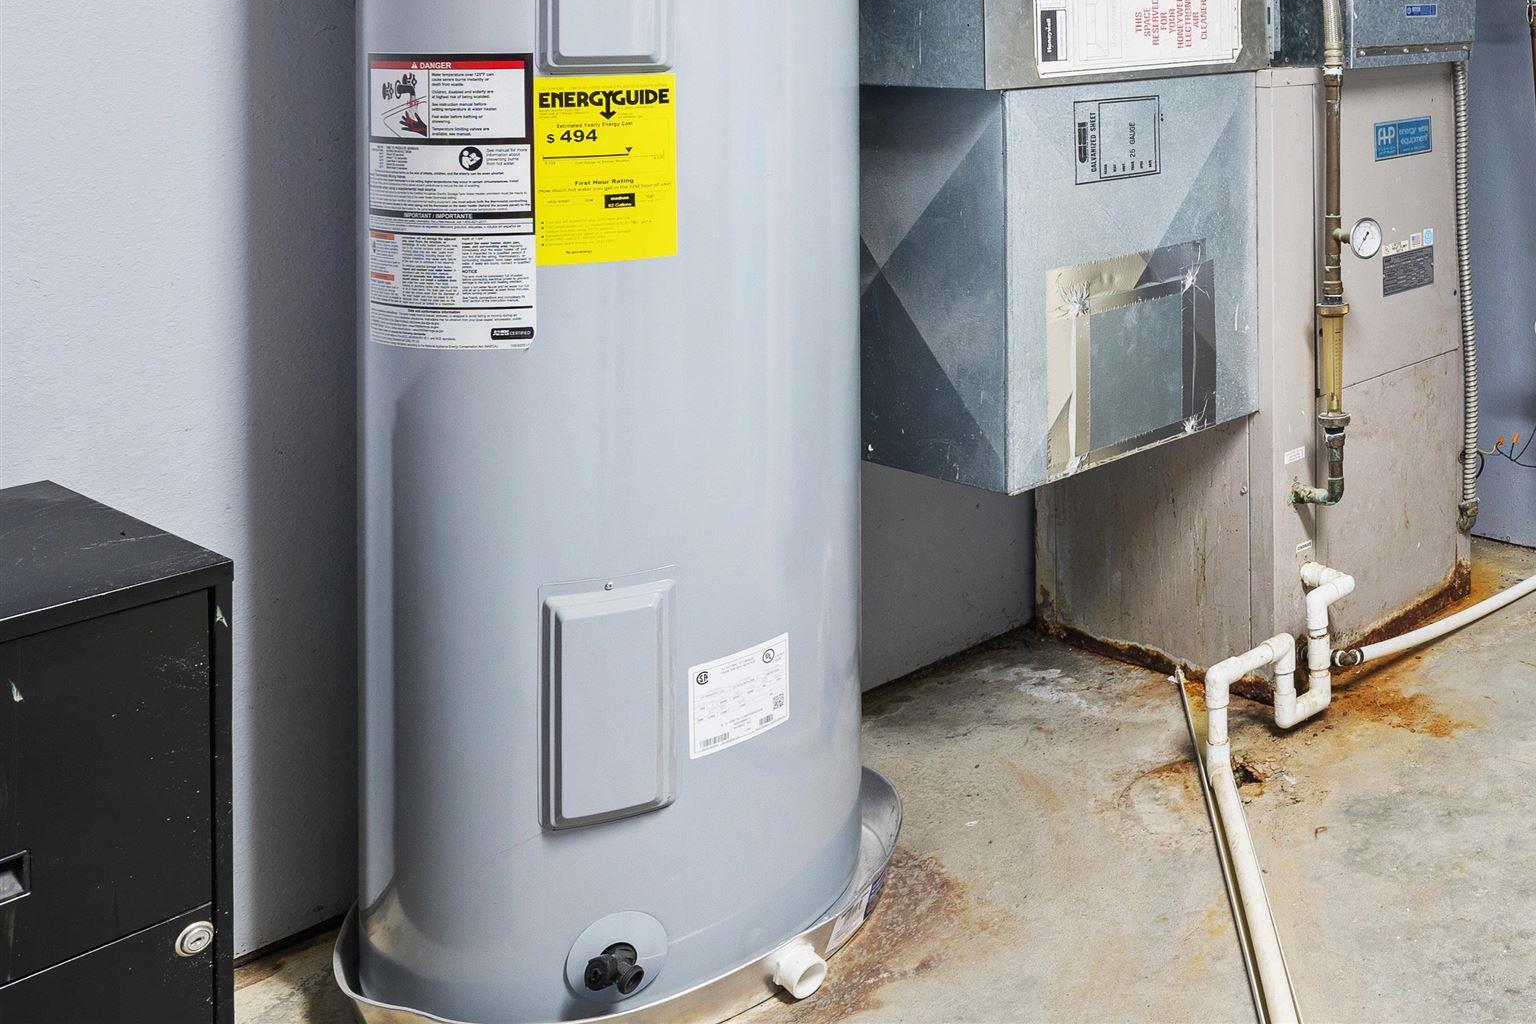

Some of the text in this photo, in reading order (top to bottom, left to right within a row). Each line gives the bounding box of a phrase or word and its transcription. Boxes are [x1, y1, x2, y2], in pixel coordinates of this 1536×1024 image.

[1135, 11, 1143, 33] THIS
[1143, 7, 1151, 37] SPACE
[1160, 12, 1168, 31] FOR
[1168, 8, 1176, 34] YOUR
[1192, 11, 1200, 28] AIR
[538, 88, 670, 111] ENERGYGUIDE
[1089, 112, 1097, 133] SHEET
[546, 129, 598, 144] $ 494
[1128, 122, 1136, 158] 26 GAUGE
[1400, 134, 1428, 145] equipment
